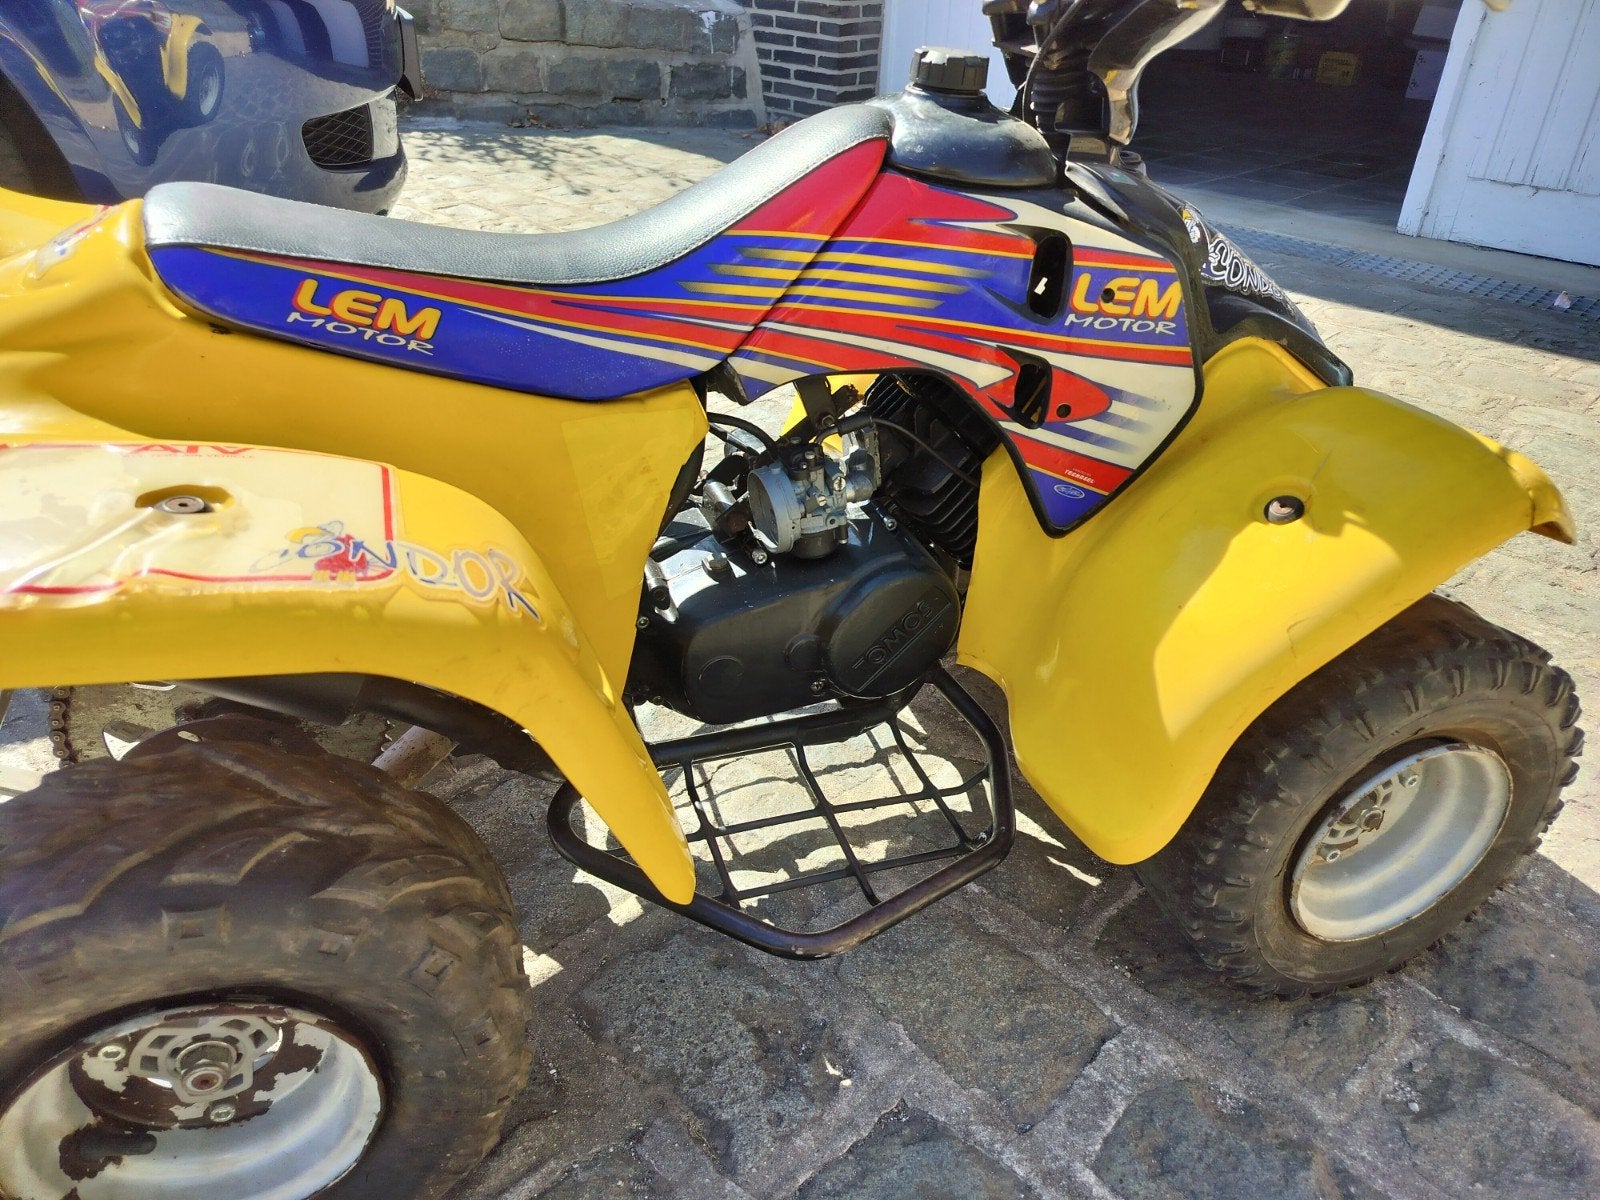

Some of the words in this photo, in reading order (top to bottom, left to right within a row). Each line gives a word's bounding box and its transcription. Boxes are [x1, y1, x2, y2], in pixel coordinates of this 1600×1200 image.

[292, 278, 442, 341] LEM
[1069, 272, 1184, 320] LEM
[286, 312, 434, 356] MOTOR
[1064, 313, 1177, 336] MOTOR
[851, 600, 934, 671] TOMOS
